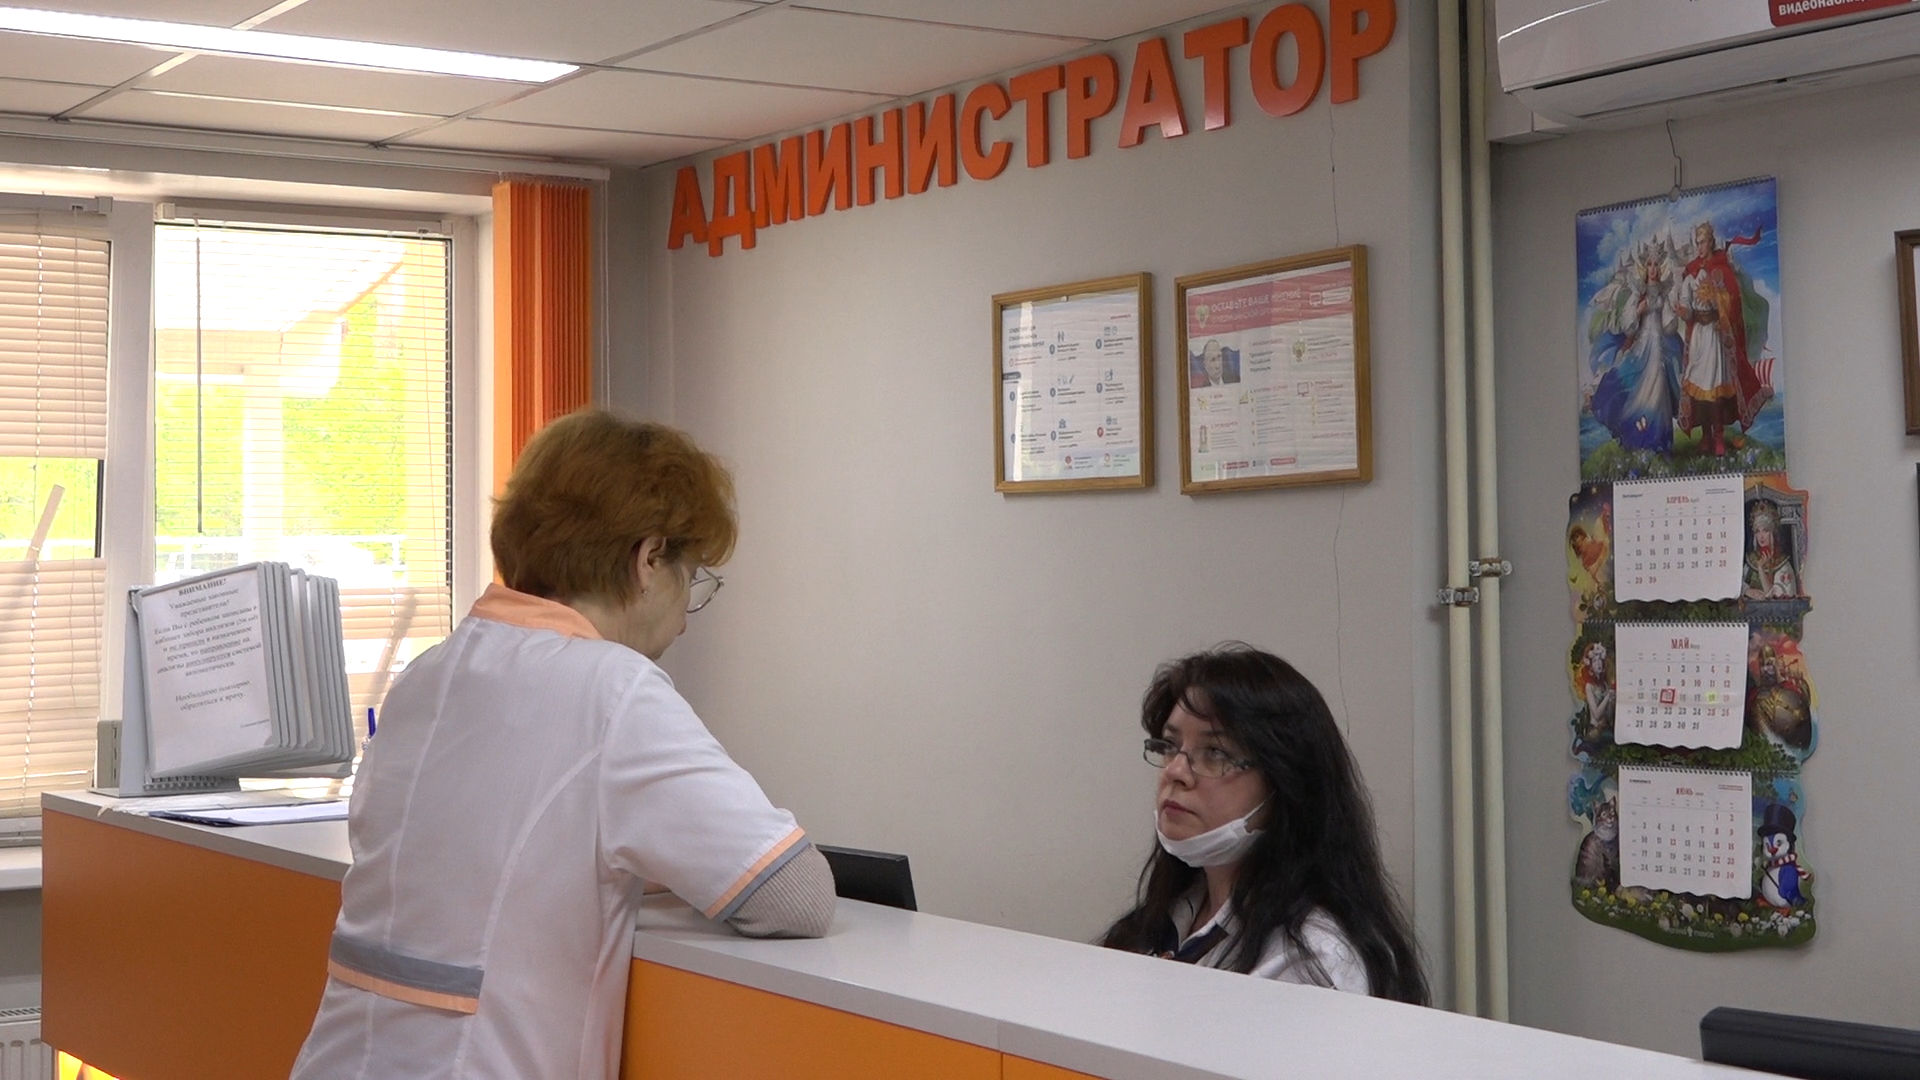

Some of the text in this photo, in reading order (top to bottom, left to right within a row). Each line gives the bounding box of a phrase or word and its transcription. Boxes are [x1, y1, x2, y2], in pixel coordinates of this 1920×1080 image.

[668, 0, 1397, 257] АДМИНИСТРАТОР
[1211, 298, 1247, 313] ОСТАВЬТЕ
[1248, 294, 1270, 306] ВАШЕ
[1666, 496, 1689, 504] АПРЕЛЬ
[178, 579, 227, 596] ВНИМАНИЕ!
[169, 597, 207, 610] Уважаемые
[1671, 637, 1689, 649] МАЙ
